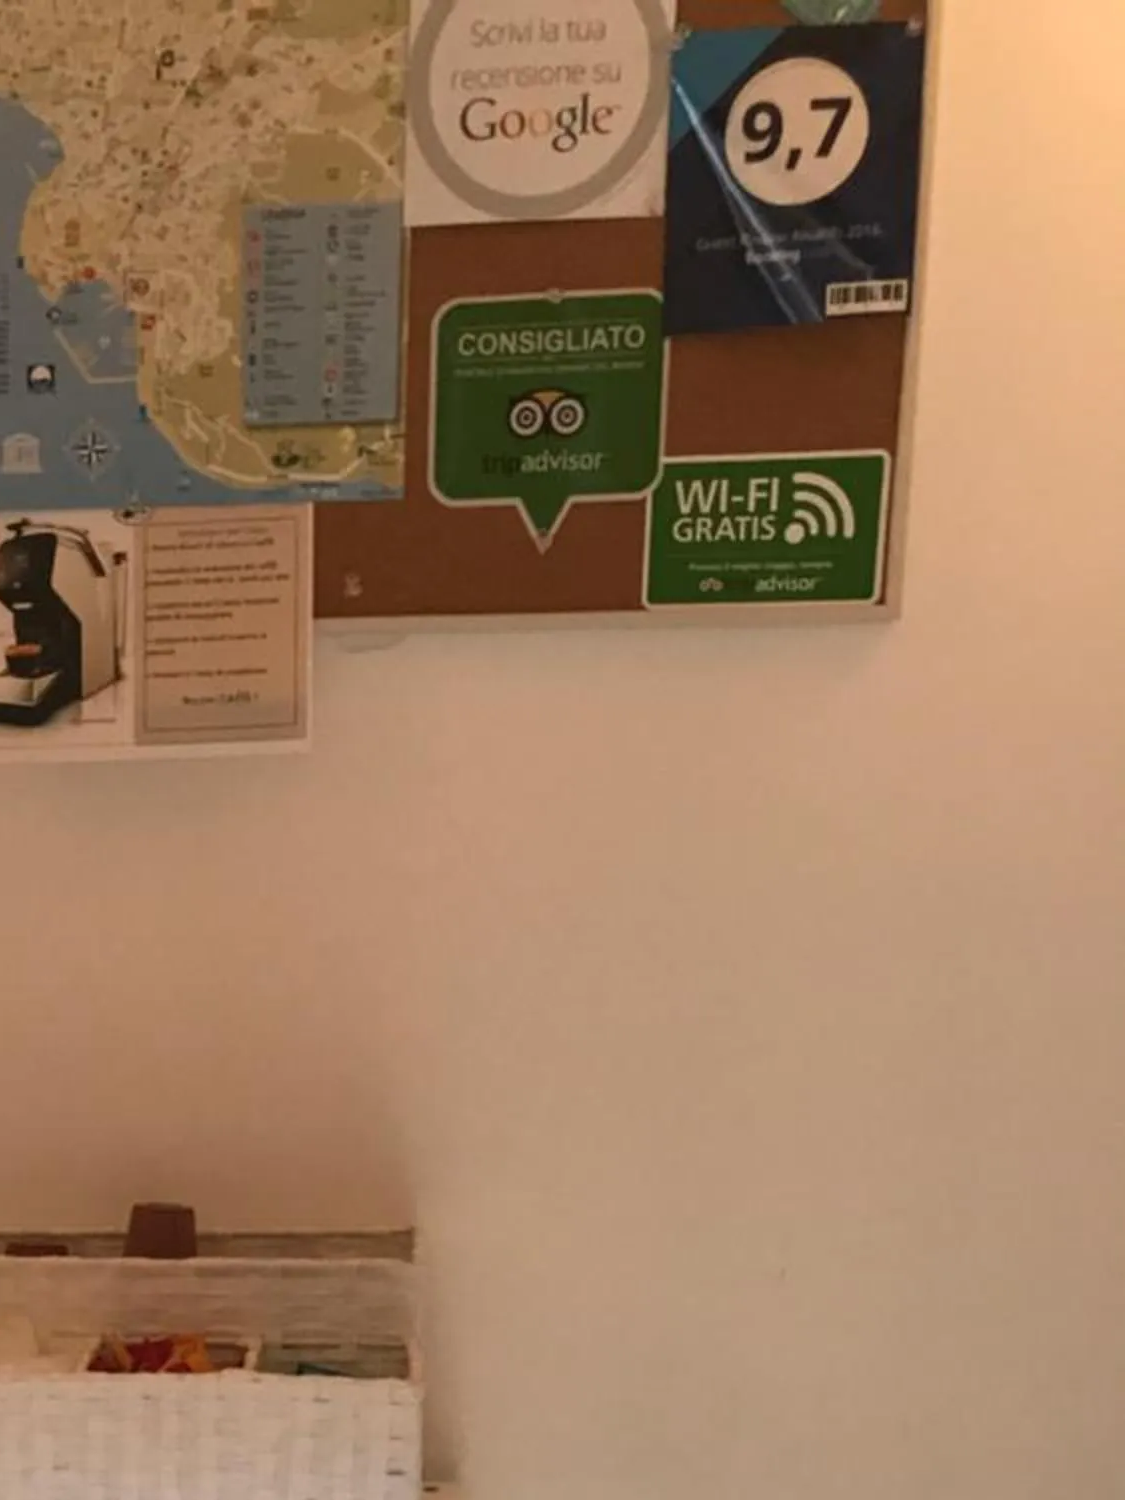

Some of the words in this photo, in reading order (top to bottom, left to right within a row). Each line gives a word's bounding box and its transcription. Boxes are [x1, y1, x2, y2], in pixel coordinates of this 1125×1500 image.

[470, 19, 533, 47] Scrivi
[539, 17, 559, 43] la
[567, 18, 607, 42] tua
[591, 62, 621, 84] su
[459, 91, 615, 153] Google
[742, 97, 852, 171] 9,7
[458, 324, 646, 356] CONSIGLIATO
[675, 477, 780, 514] WI-FI
[672, 516, 777, 543] GRATIS
